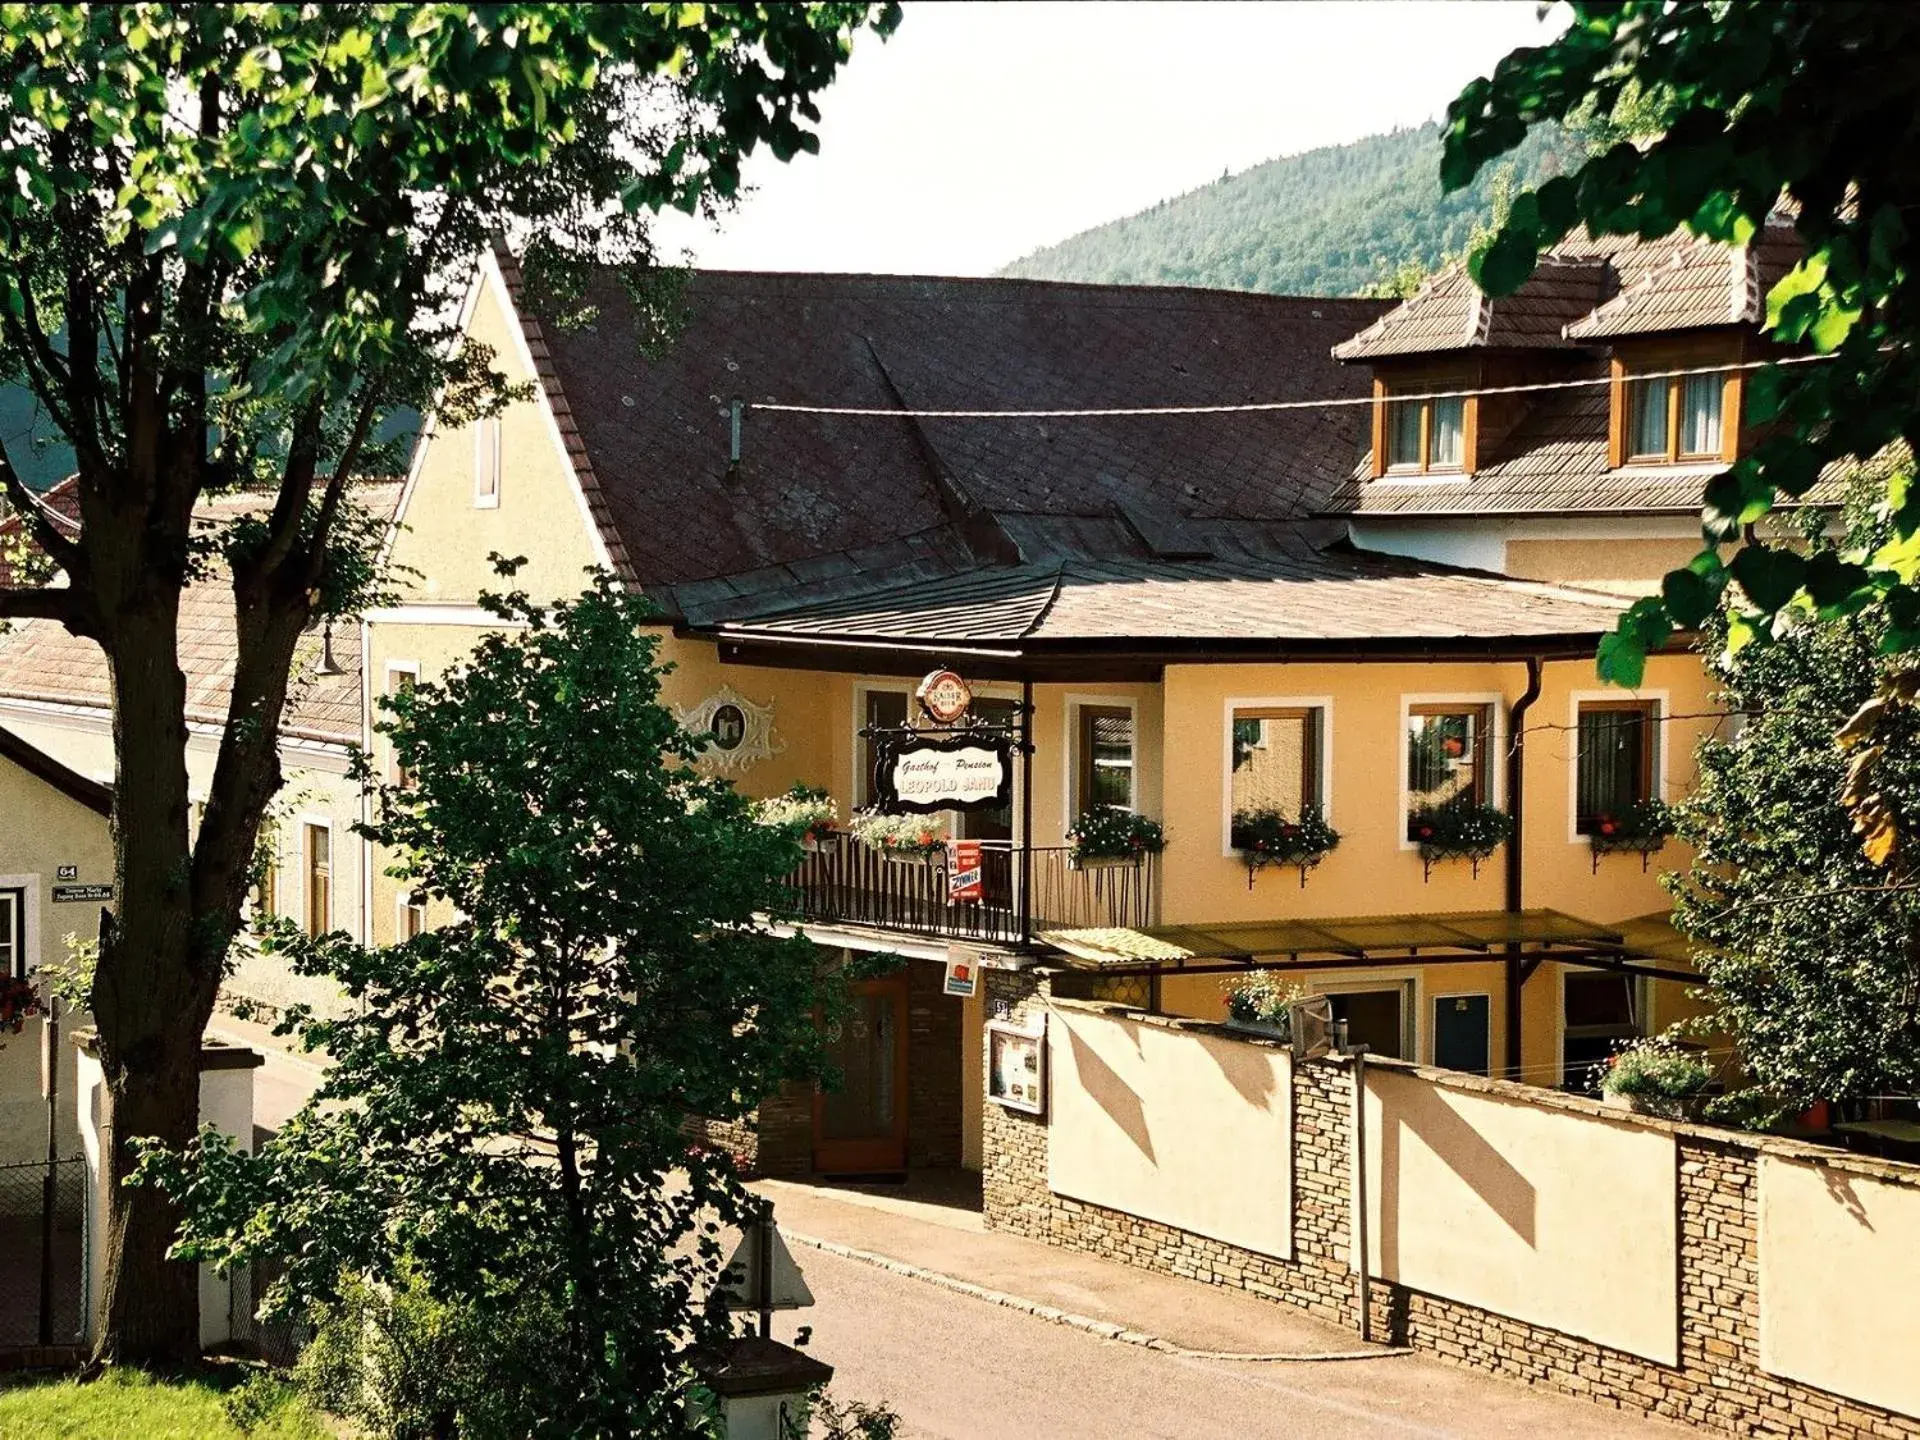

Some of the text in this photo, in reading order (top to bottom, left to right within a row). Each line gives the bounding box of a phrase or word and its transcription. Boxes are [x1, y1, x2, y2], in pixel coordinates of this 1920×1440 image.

[902, 758, 993, 775] Gasthof Pension
[900, 778, 957, 794] LEOPOLD
[59, 867, 75, 877] 64
